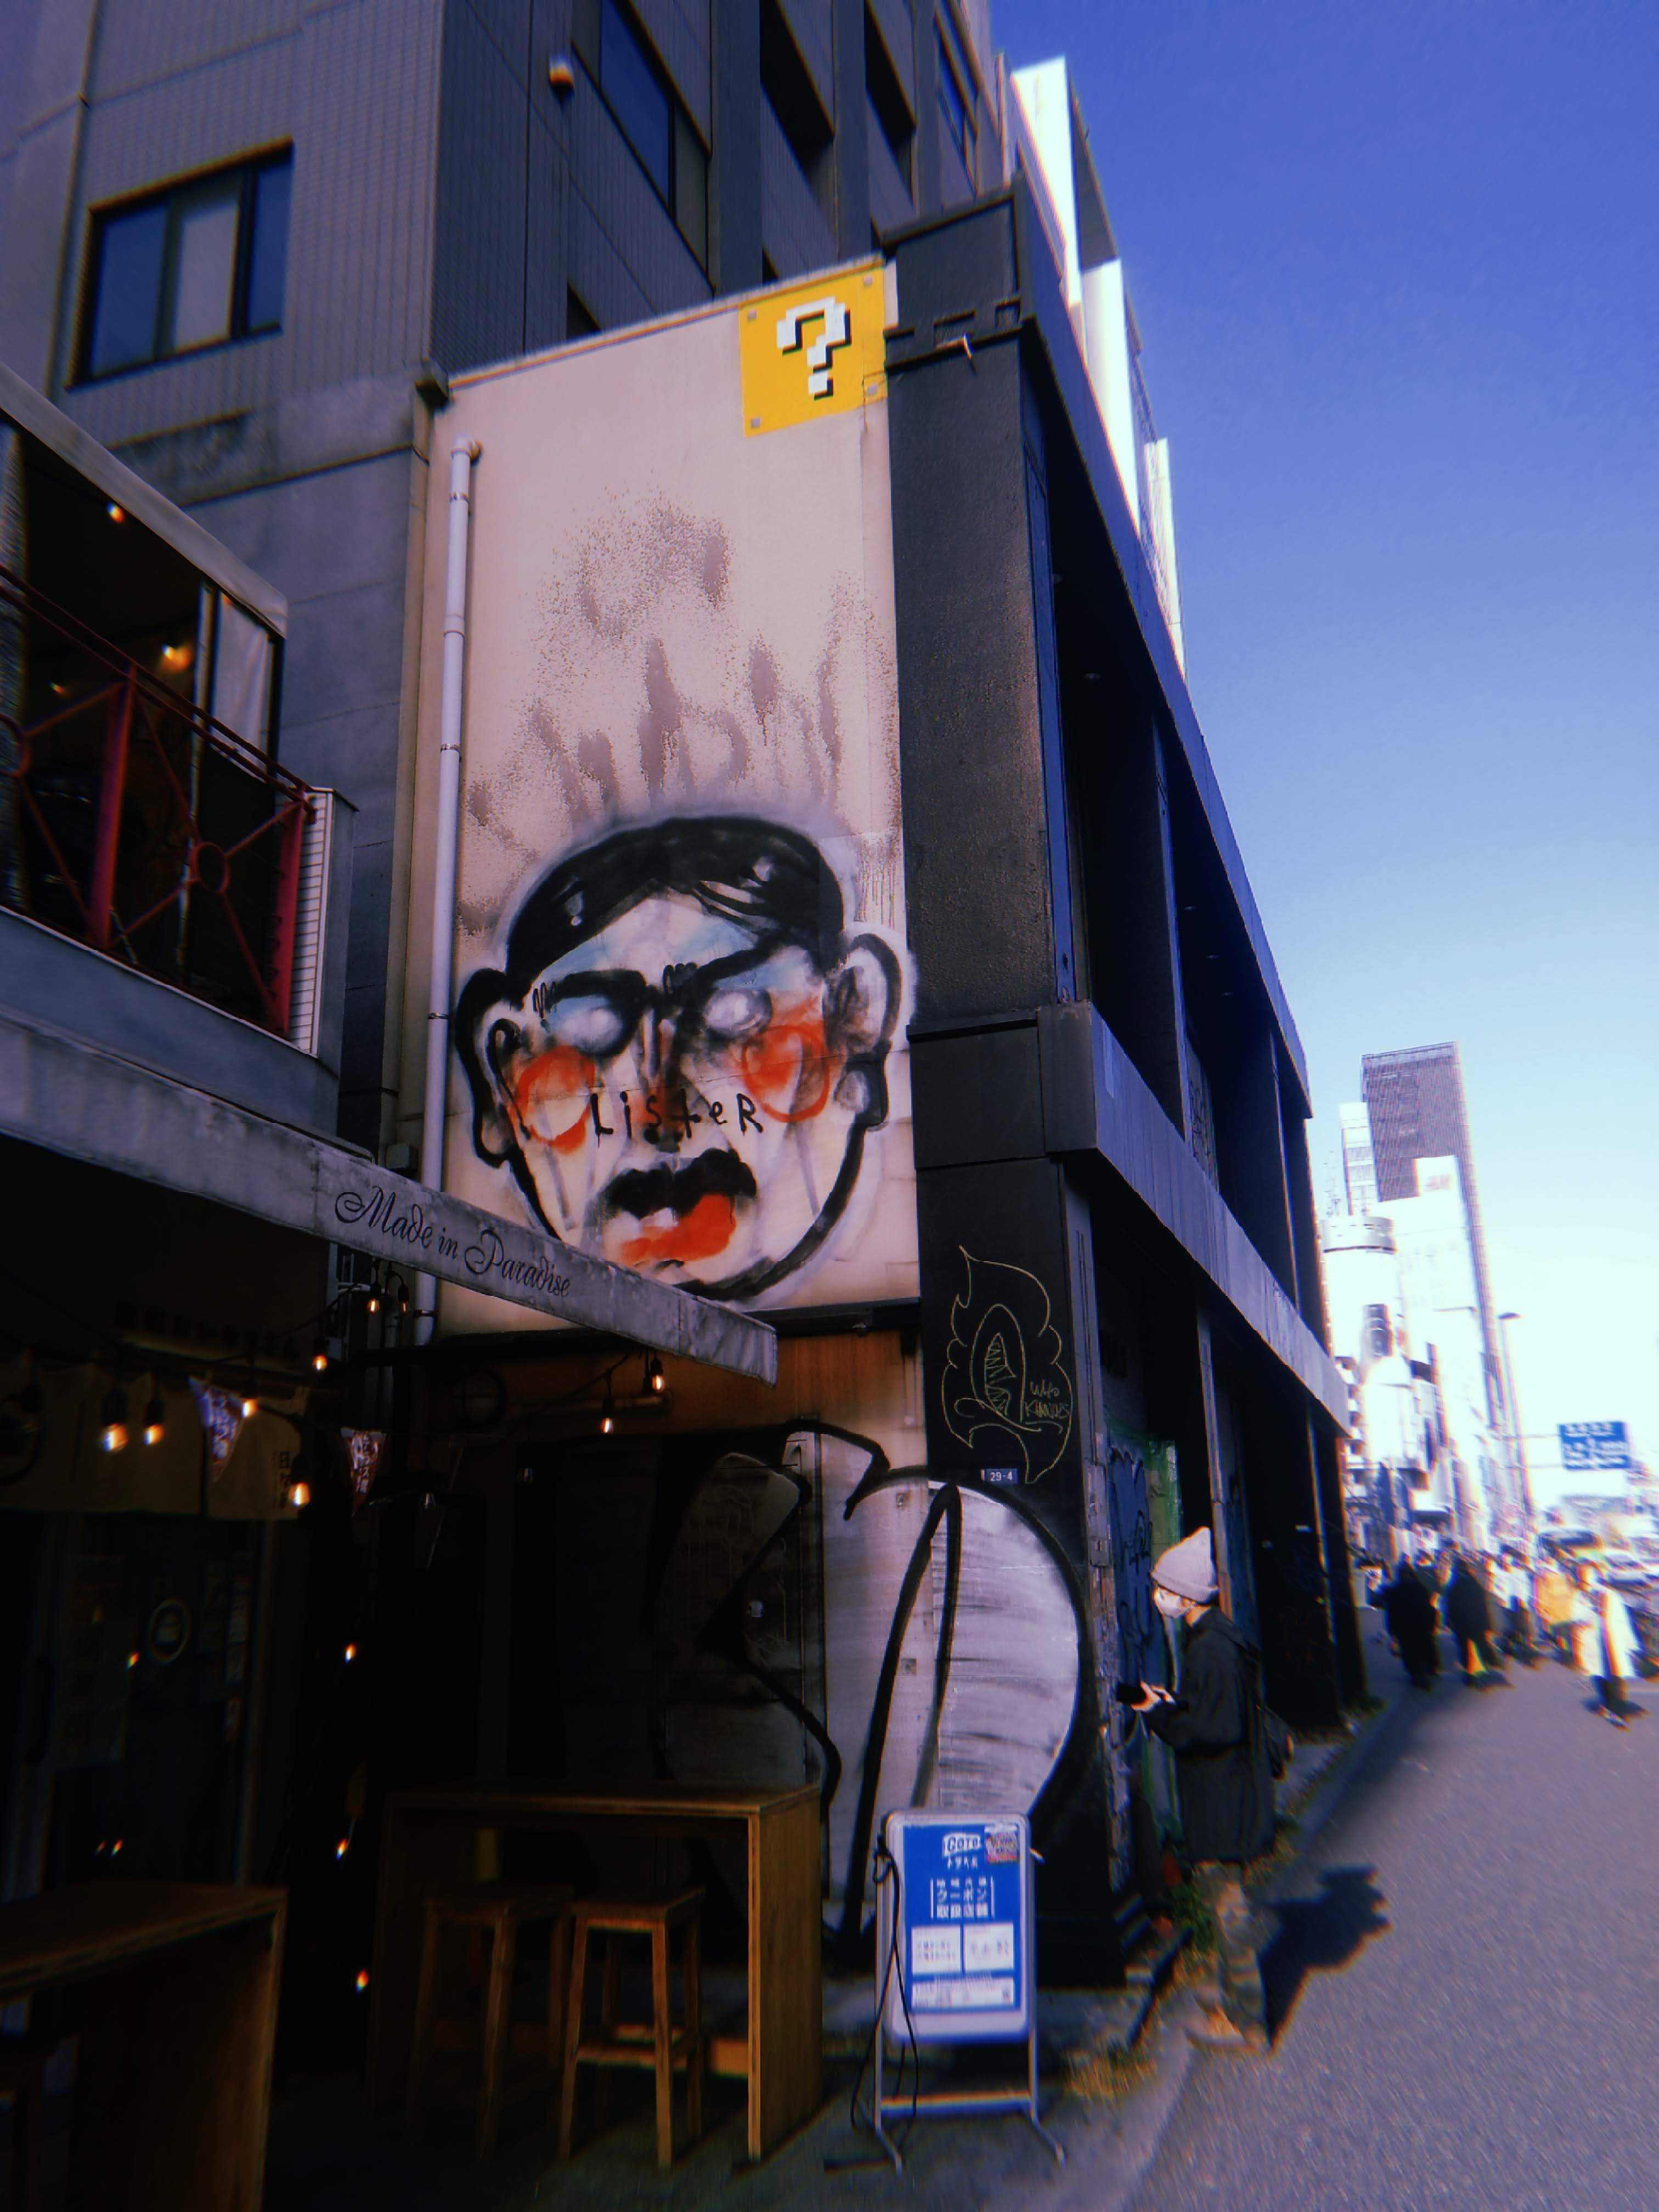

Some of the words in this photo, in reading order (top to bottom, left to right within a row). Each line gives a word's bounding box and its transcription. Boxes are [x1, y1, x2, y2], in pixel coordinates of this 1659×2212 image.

[335, 1185, 433, 1248] Made
[438, 1227, 459, 1259] in
[464, 1229, 571, 1297] Paradise
[989, 1471, 1013, 1481] 29-4
